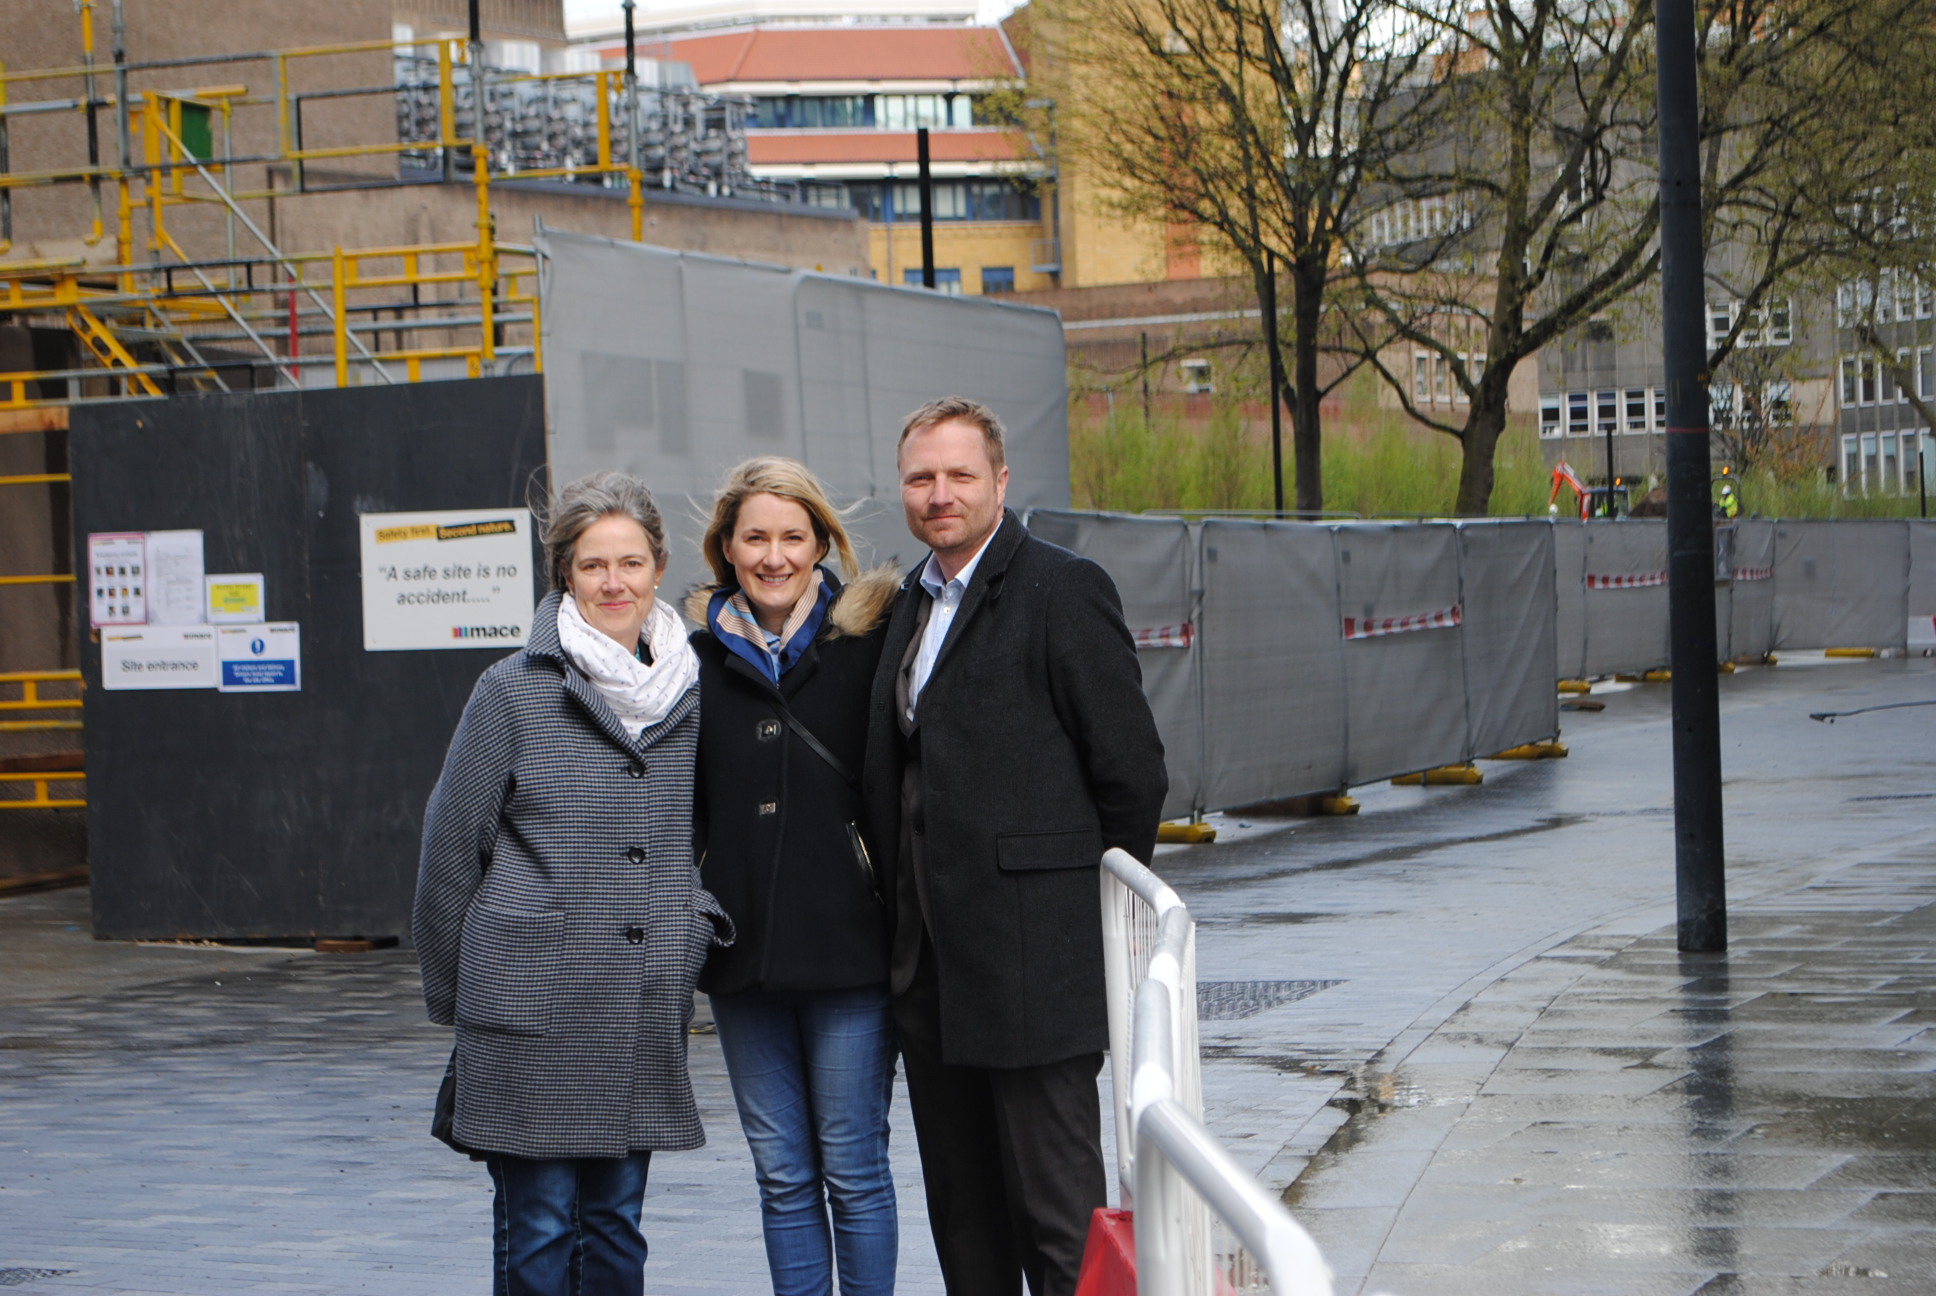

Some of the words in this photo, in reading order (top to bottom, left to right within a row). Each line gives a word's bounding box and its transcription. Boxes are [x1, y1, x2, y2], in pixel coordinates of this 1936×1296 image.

[378, 528, 408, 542] Safety
[438, 524, 477, 539] Second
[478, 521, 514, 535] nature.
[403, 563, 437, 581] safe
[442, 563, 473, 580] site
[477, 562, 491, 579] is
[496, 564, 518, 579] no
[470, 624, 521, 638] mace
[121, 658, 145, 673] Site
[147, 659, 200, 673] entrance
